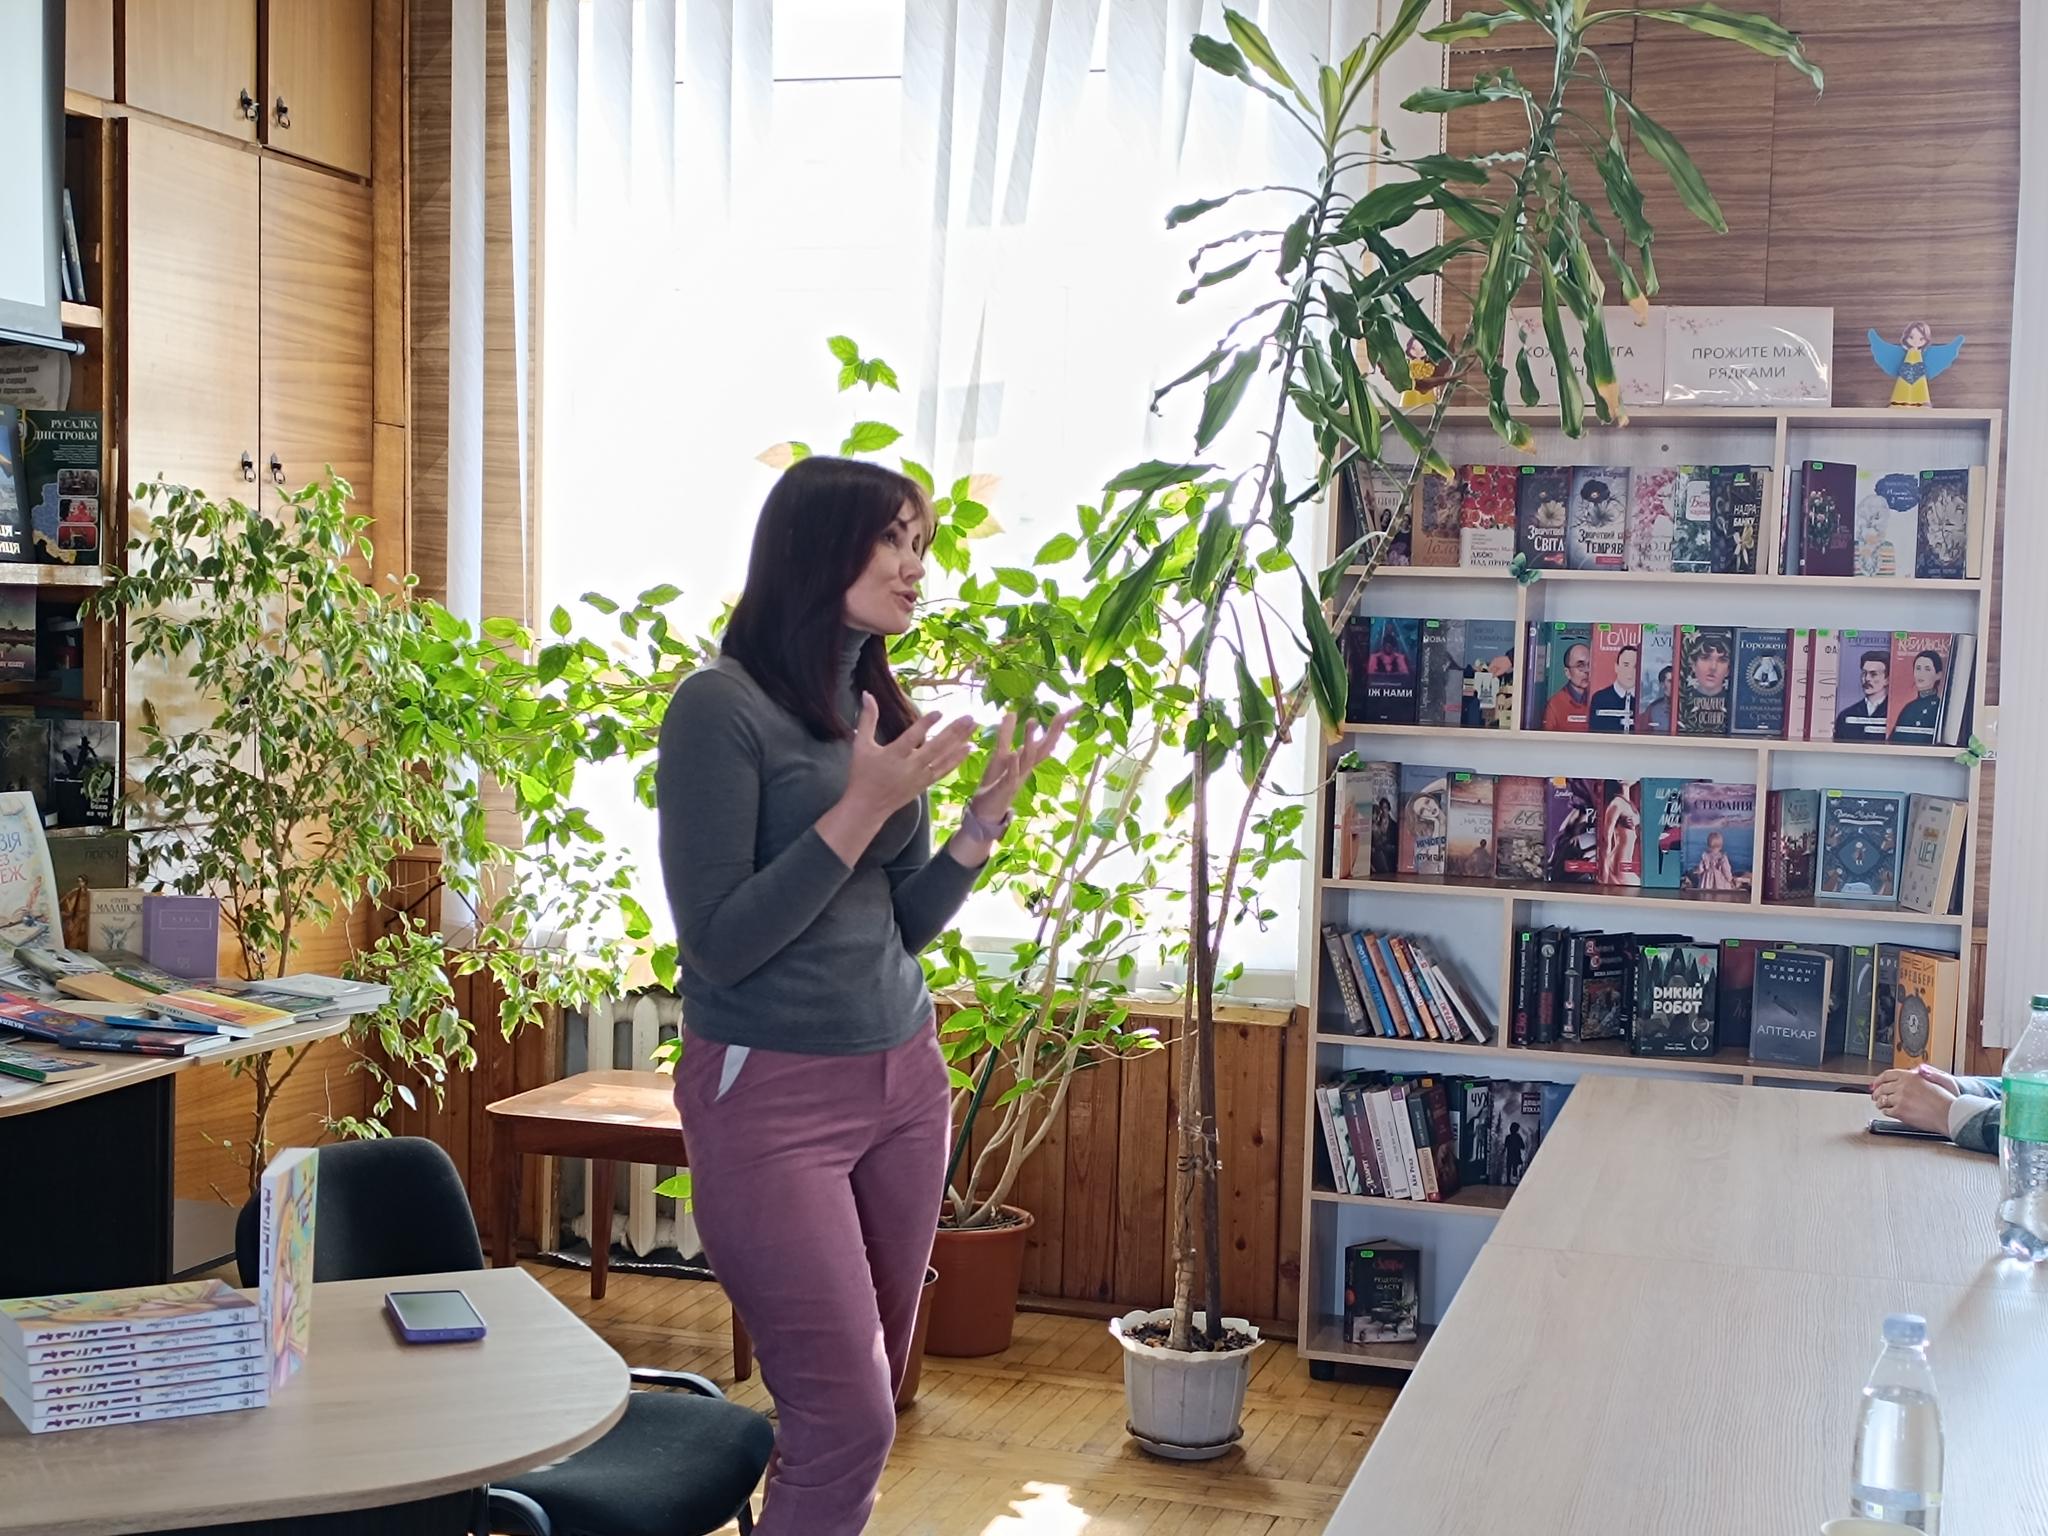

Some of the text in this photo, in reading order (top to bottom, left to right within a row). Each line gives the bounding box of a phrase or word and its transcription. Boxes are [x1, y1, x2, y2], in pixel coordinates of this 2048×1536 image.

[1525, 346, 1579, 358] КОА
[1692, 346, 1768, 359] ПРОЖИТЕ
[1708, 366, 1786, 379] РЯДКАМИ
[51, 420, 98, 429] РУСАЛКА
[35, 431, 98, 440] ДНІСТРОВАЯ
[1585, 540, 1625, 554] ТЕМРЯВ
[1383, 688, 1413, 697] НАМИ
[1694, 800, 1754, 812] СТЕФАНІЯ
[1653, 983, 1704, 1000] ДИКИЙ
[1652, 1000, 1703, 1015] РОБОТ
[1756, 1024, 1818, 1041] АПТЕКАР
